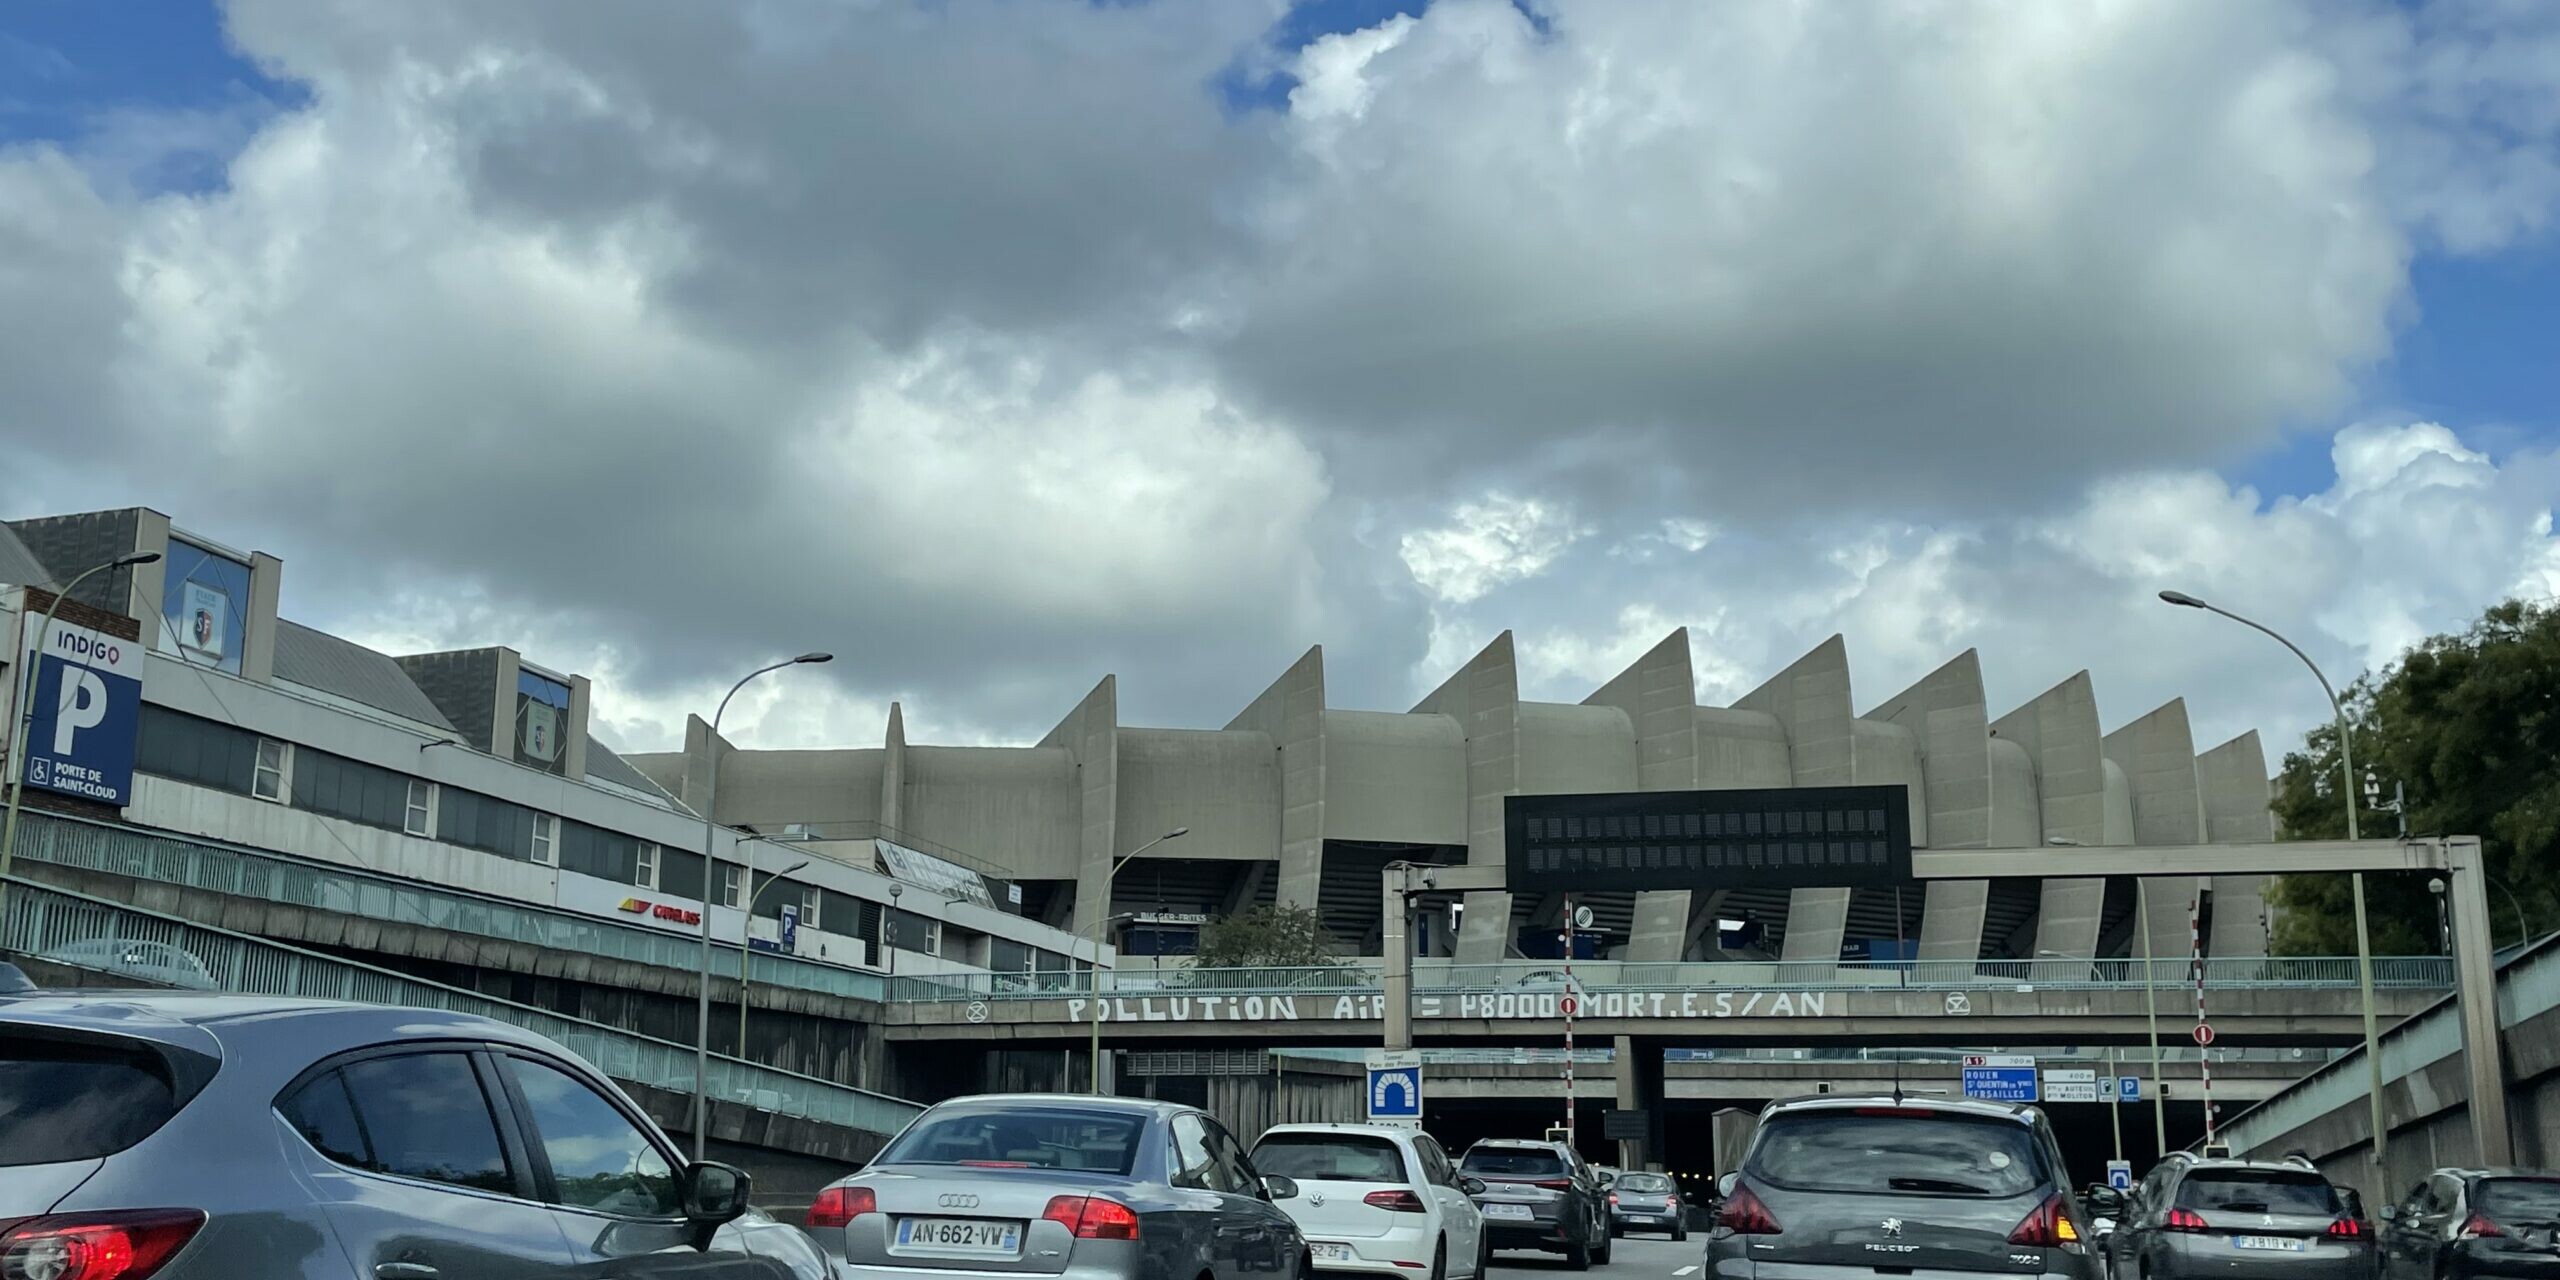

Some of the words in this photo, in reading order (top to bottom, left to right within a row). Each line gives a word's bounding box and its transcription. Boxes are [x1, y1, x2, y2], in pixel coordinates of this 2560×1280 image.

[58, 630, 119, 665] INDIGO
[54, 664, 107, 756] P
[55, 762, 86, 779] PORTE
[88, 769, 102, 783] DE
[53, 776, 117, 800] SAINT-CLOUD
[784, 916, 792, 934] P
[1966, 1071, 1998, 1079] ROUEN
[1977, 1080, 2008, 1089] QUENTIN
[2125, 1081, 2134, 1093] P
[1967, 1090, 2025, 1099] VERSAILLES
